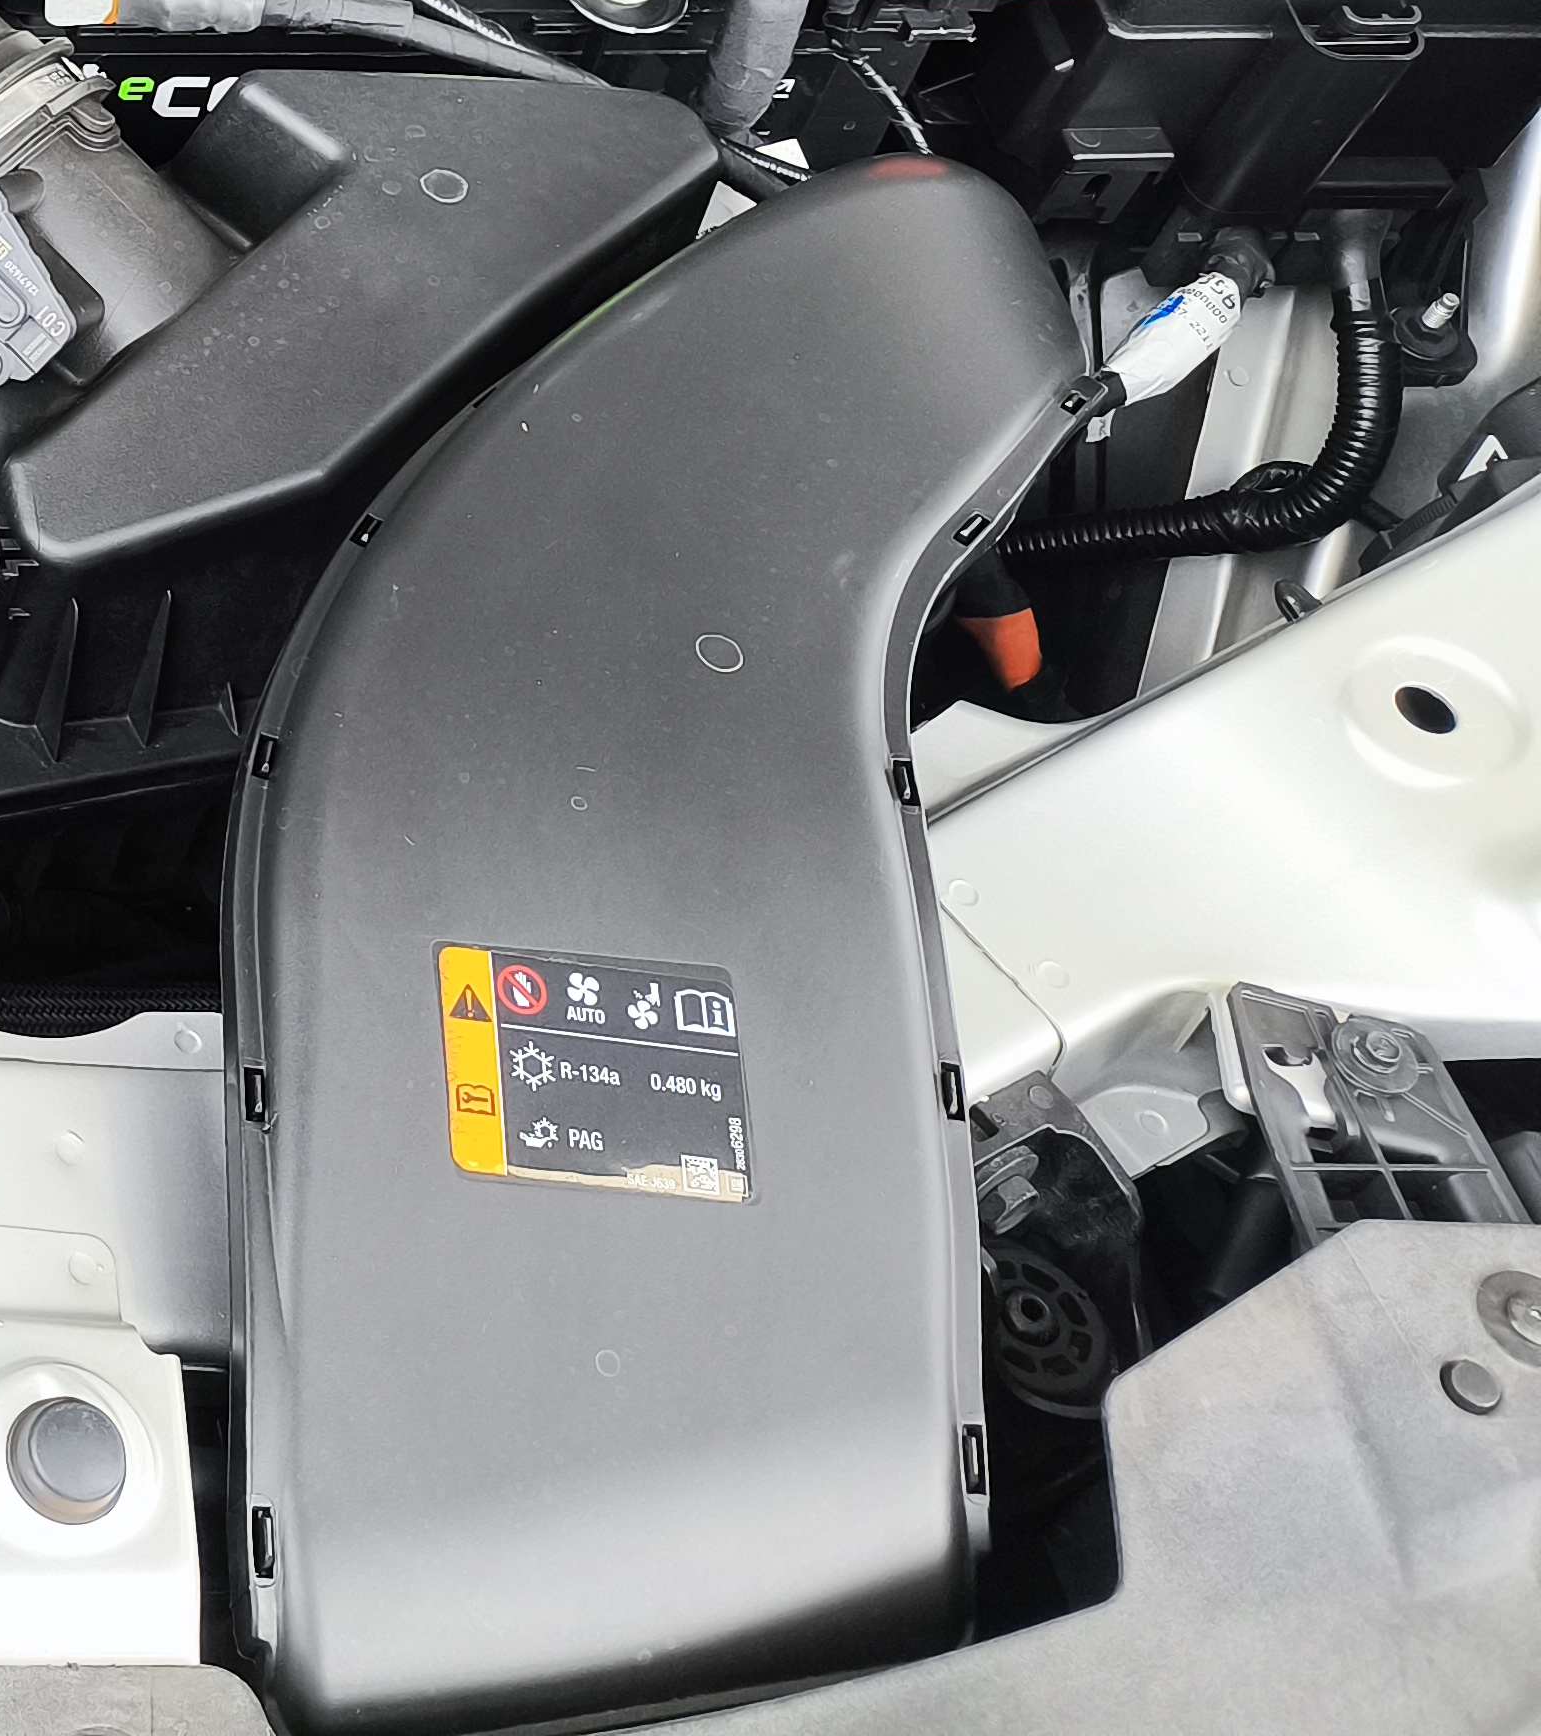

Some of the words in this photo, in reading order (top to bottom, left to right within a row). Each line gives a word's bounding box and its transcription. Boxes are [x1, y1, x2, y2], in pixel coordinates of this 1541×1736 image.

[118, 76, 239, 117] ec
[567, 1006, 606, 1025] AUTO
[560, 1061, 621, 1086] R-134a
[650, 1073, 696, 1095] 0.480
[700, 1078, 722, 1101] kg
[568, 1128, 604, 1152] PAG
[626, 1173, 649, 1188] SAE
[651, 1176, 676, 1191] J639
